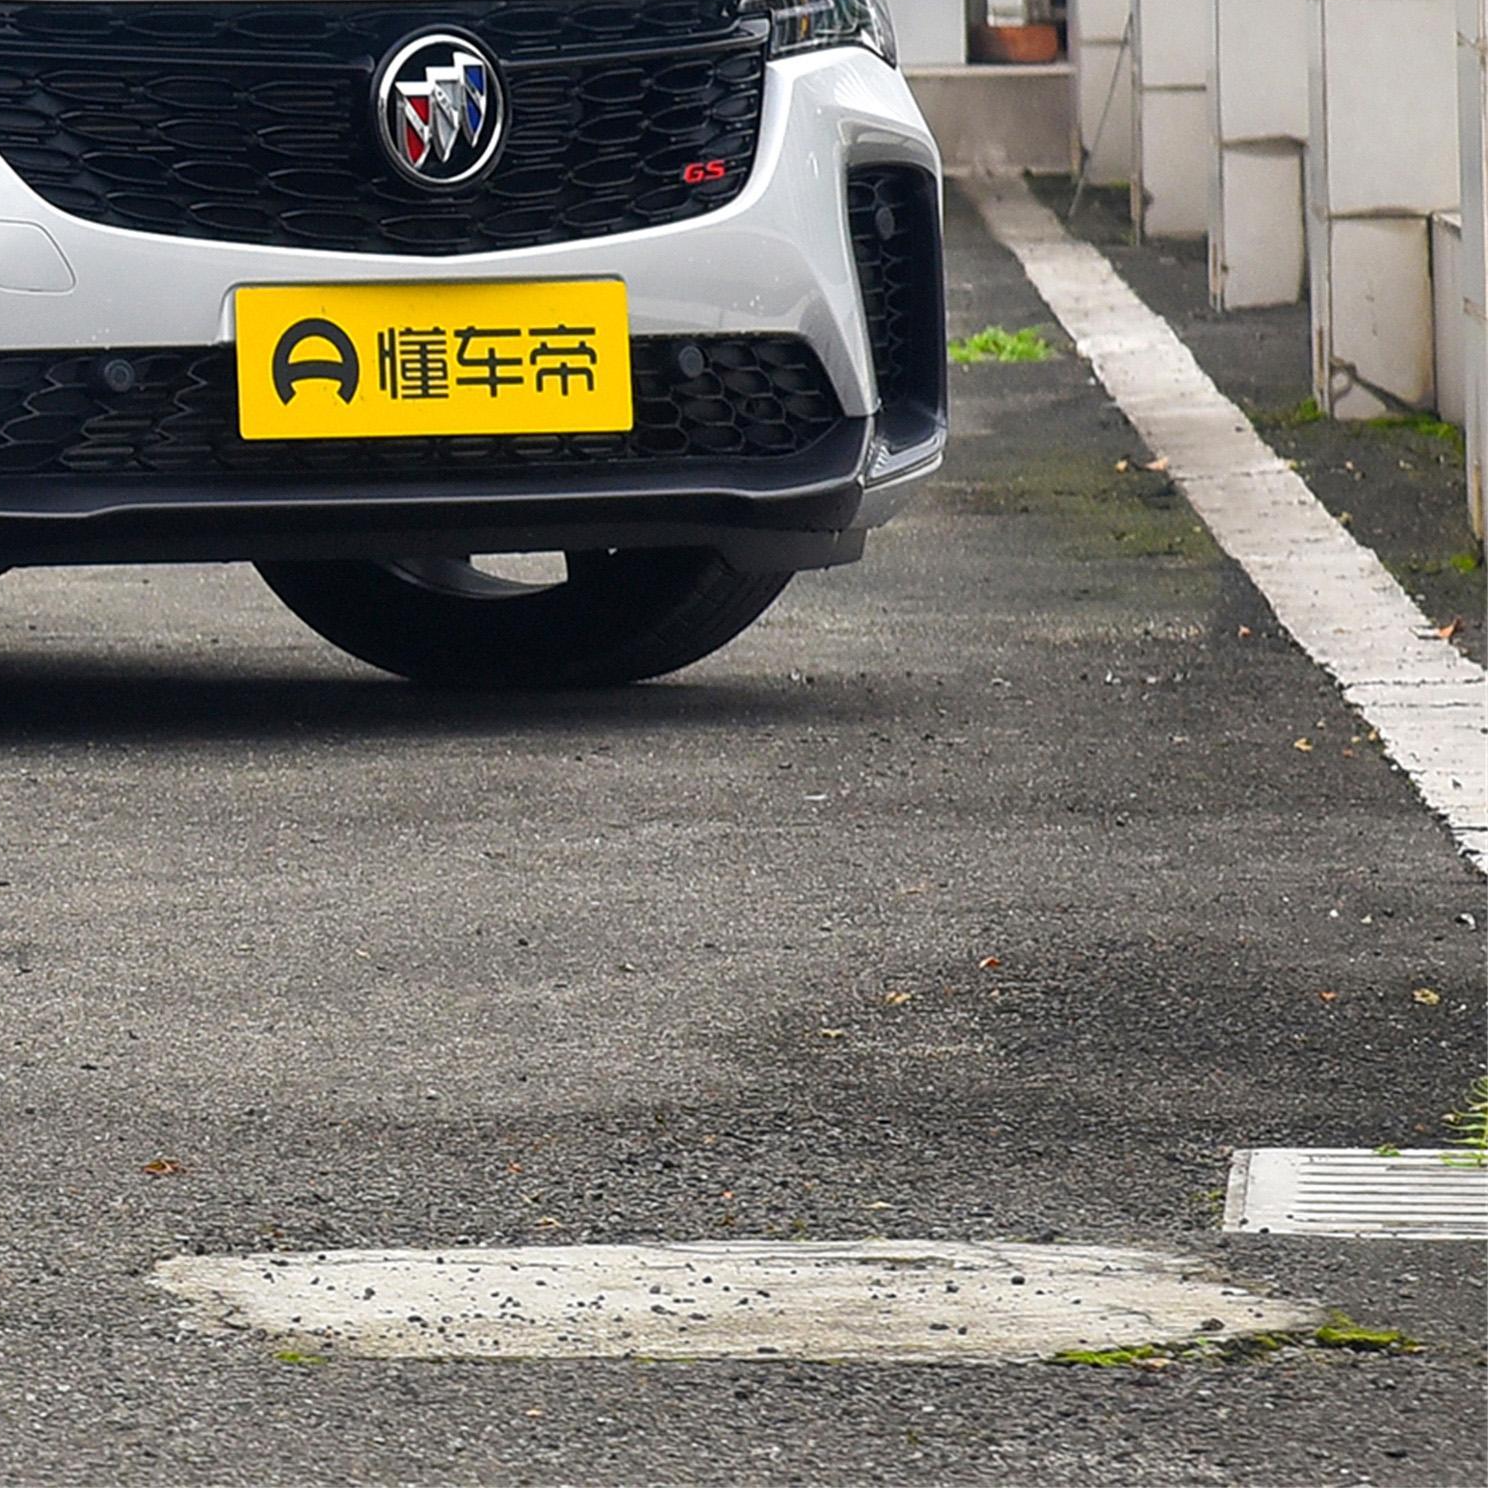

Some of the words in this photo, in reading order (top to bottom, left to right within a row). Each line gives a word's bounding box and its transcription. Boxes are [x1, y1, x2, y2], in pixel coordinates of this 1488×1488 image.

[683, 159, 725, 184] GS
[377, 324, 598, 400] 懂车帝
